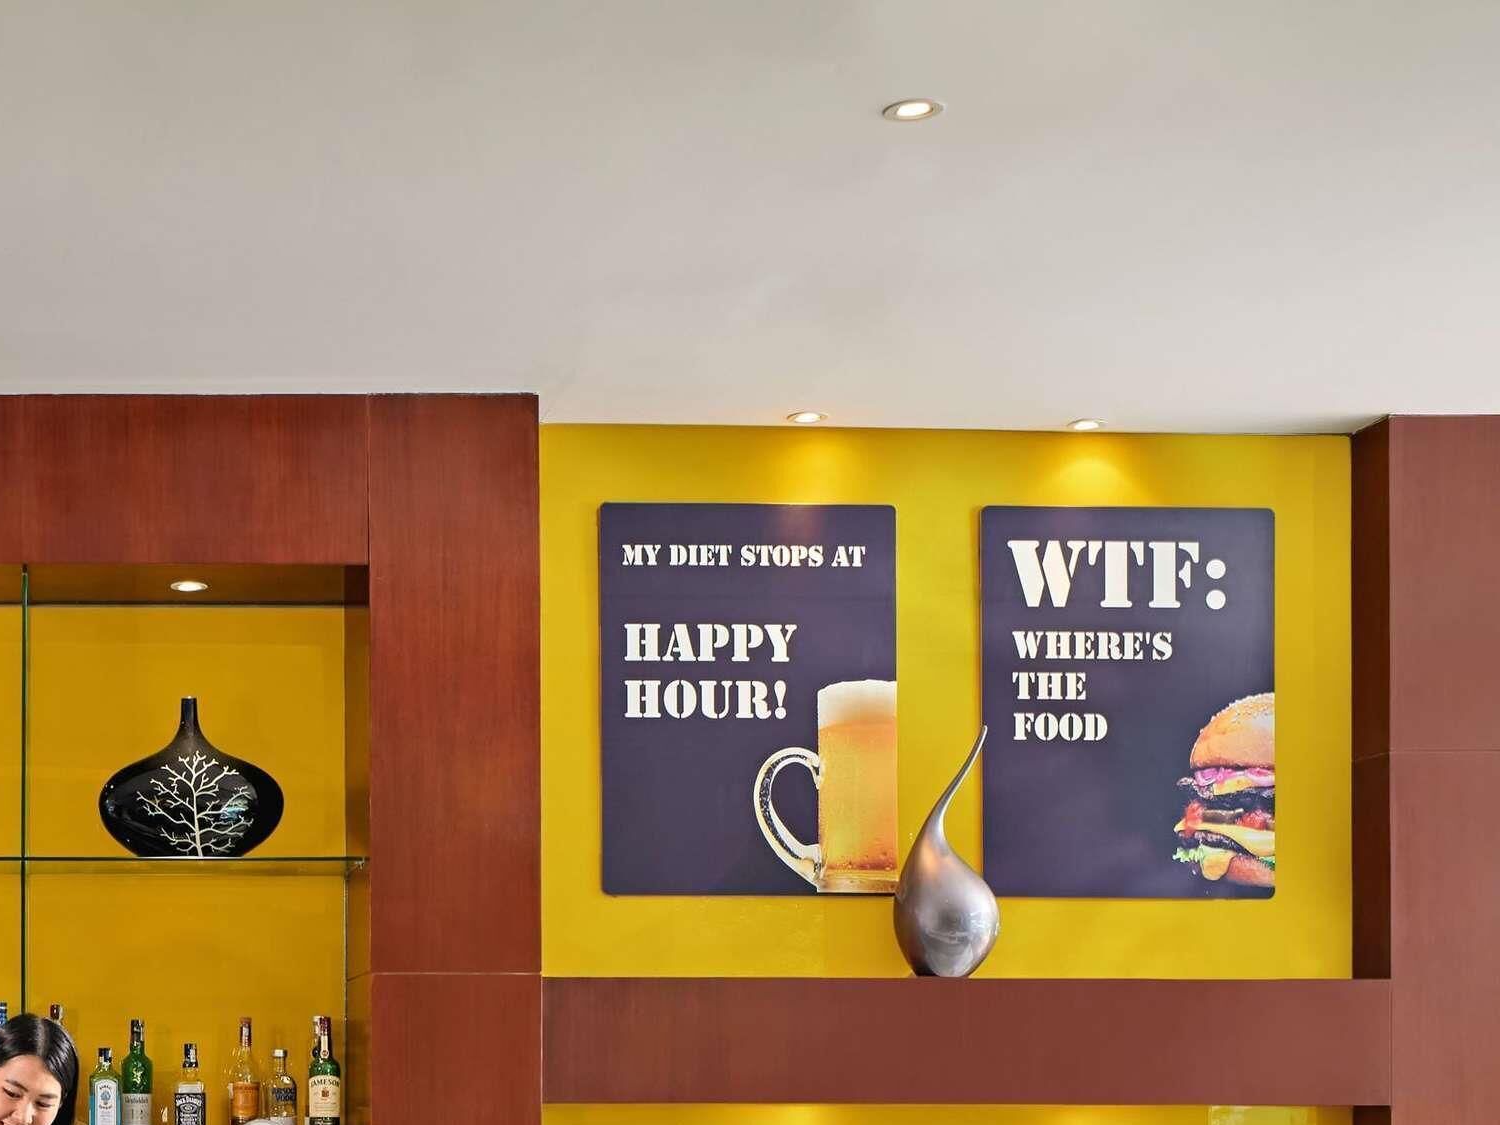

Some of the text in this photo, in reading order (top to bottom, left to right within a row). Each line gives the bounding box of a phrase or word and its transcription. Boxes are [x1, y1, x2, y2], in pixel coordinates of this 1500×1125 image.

[622, 544, 865, 567] MY DIET STOPS AT
[1007, 540, 1228, 610] WTF:
[624, 624, 797, 662] HAPPY
[1012, 631, 1172, 660] WHERE'S
[624, 680, 786, 719] HOUR!
[1012, 672, 1086, 700] THE
[1014, 712, 1107, 741] FOOD
